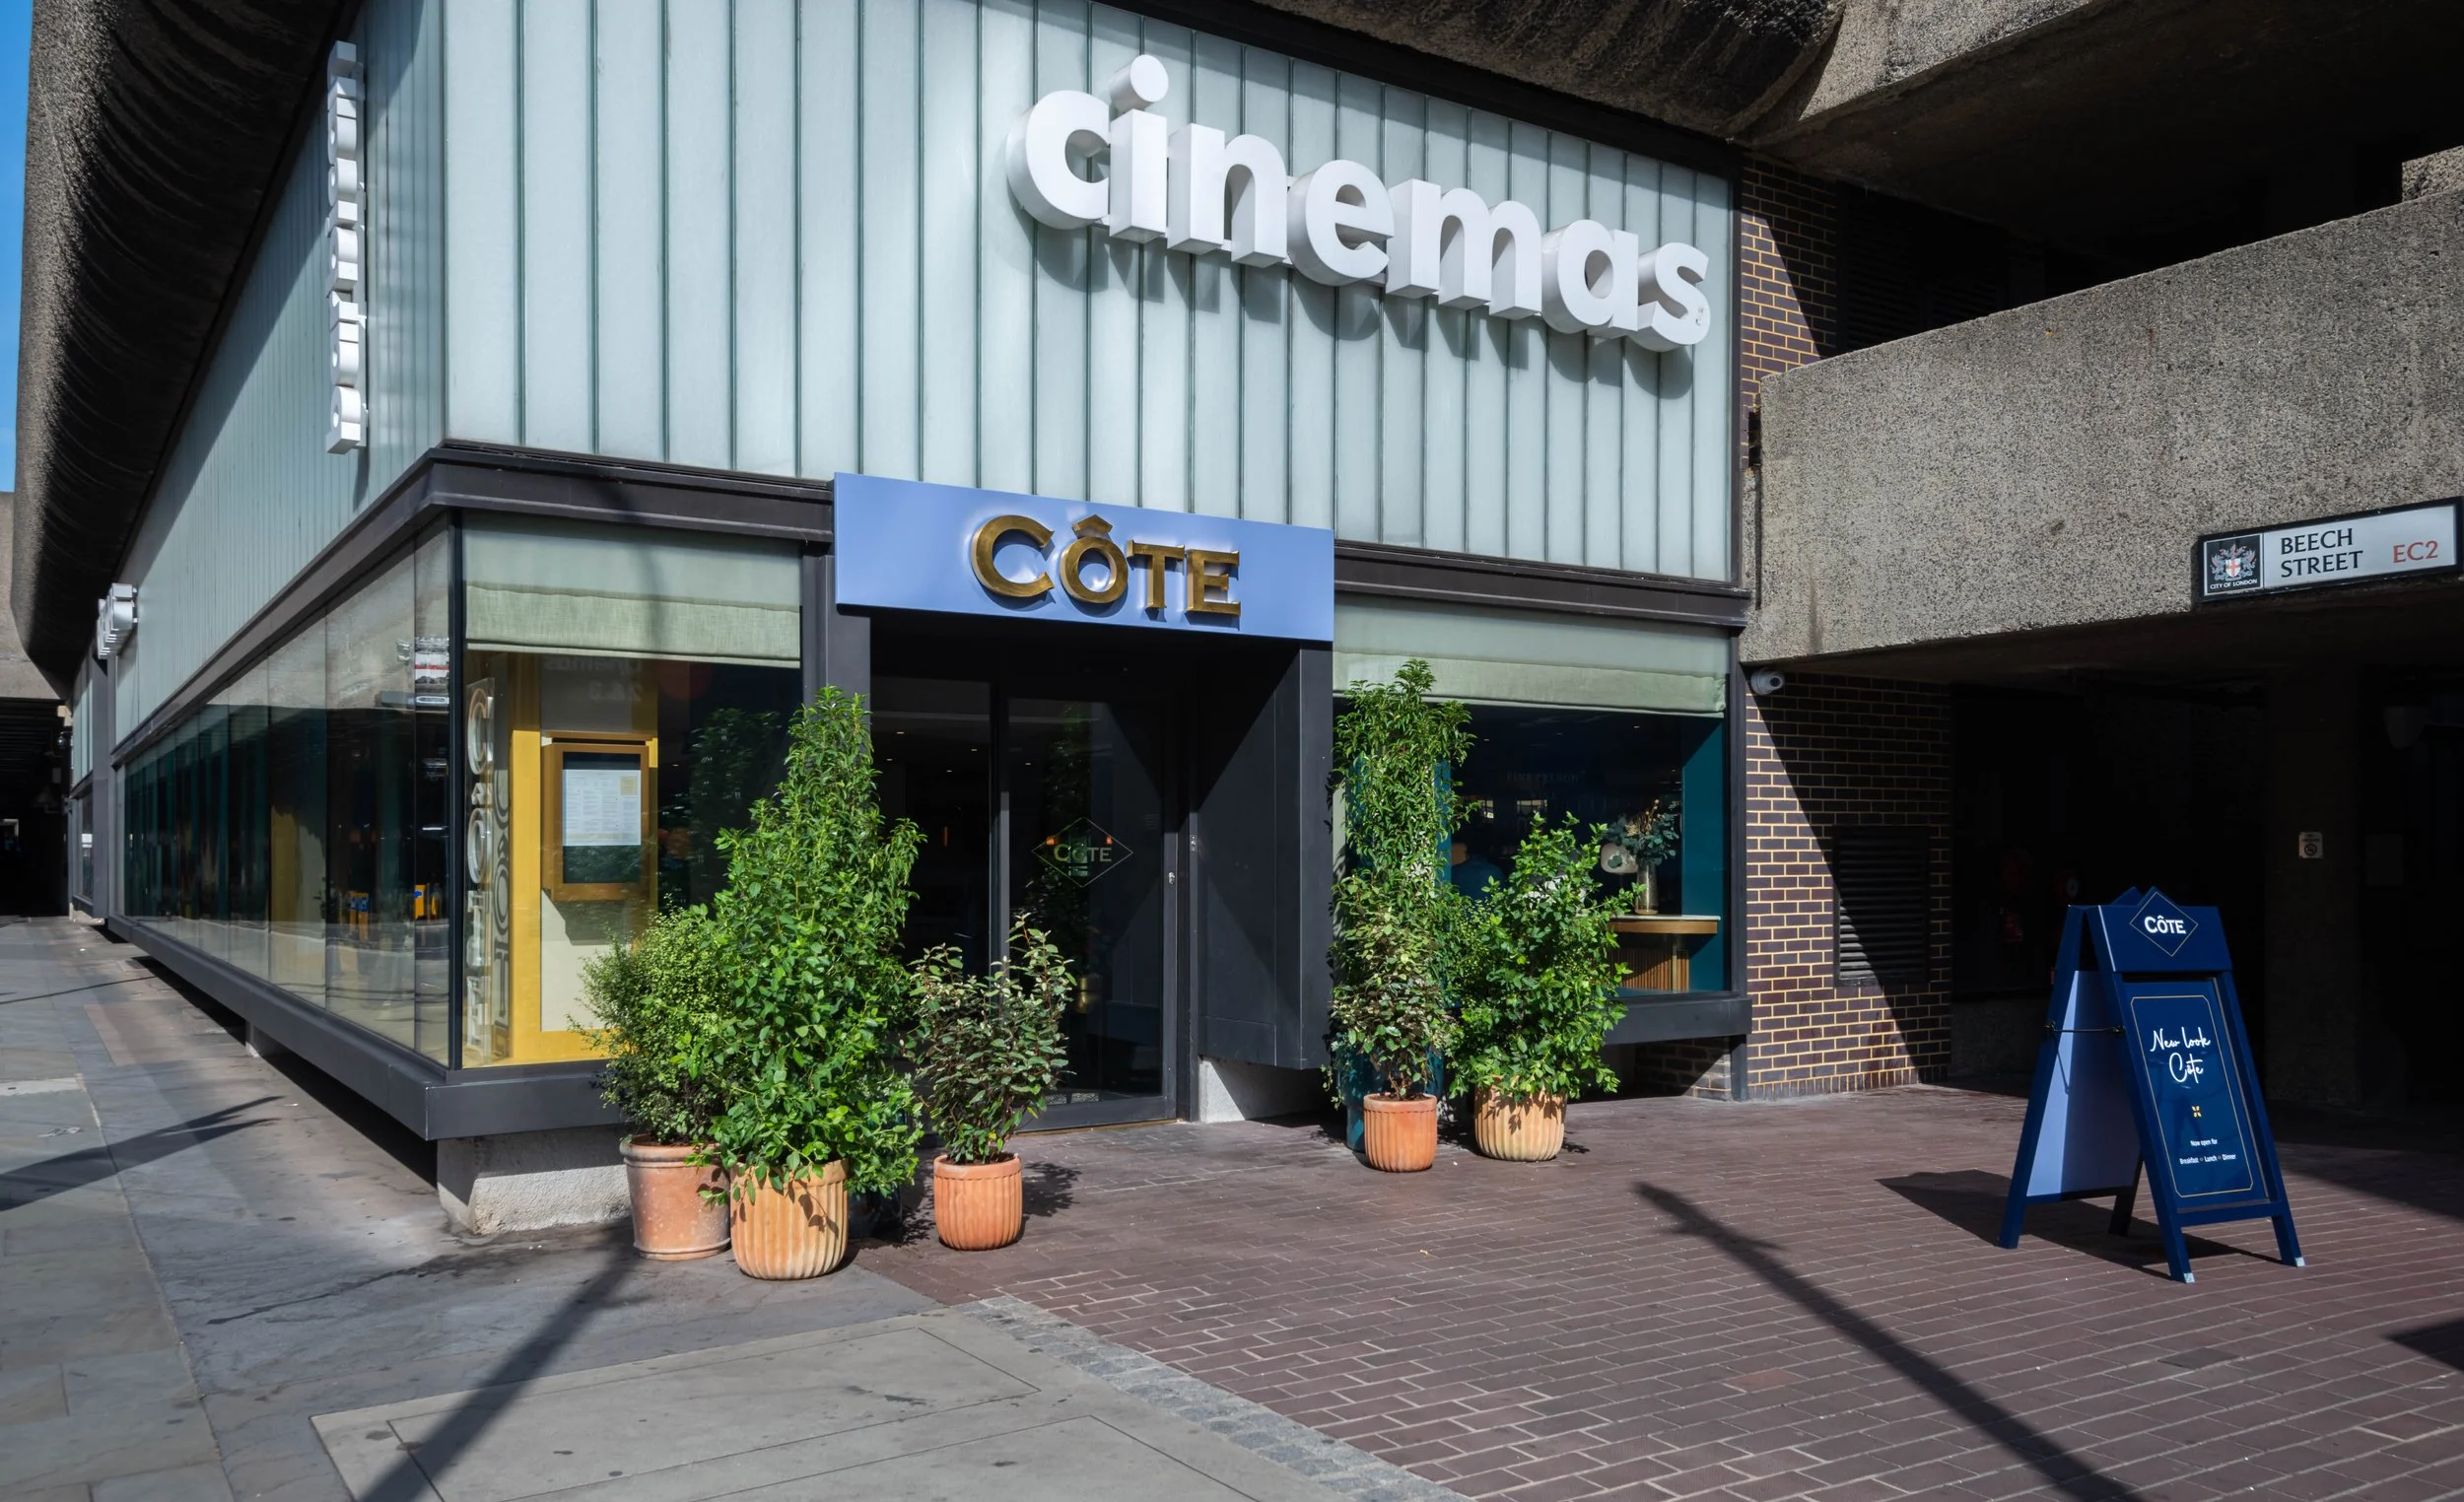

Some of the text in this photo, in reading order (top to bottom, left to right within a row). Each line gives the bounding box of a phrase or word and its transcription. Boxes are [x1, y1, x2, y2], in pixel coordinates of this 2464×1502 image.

[1005, 54, 1711, 352] cinemas
[2280, 527, 2354, 555] BEECH
[970, 513, 1242, 617] CÔTE
[2280, 540, 2439, 578] STREET EC2
[2144, 915, 2186, 934] CÔTE
[2150, 1026, 2211, 1052] New look
[2168, 1052, 2204, 1083] Côte
[2179, 1156, 2200, 1165] Breakfast
[2204, 1154, 2218, 1163] Lunch
